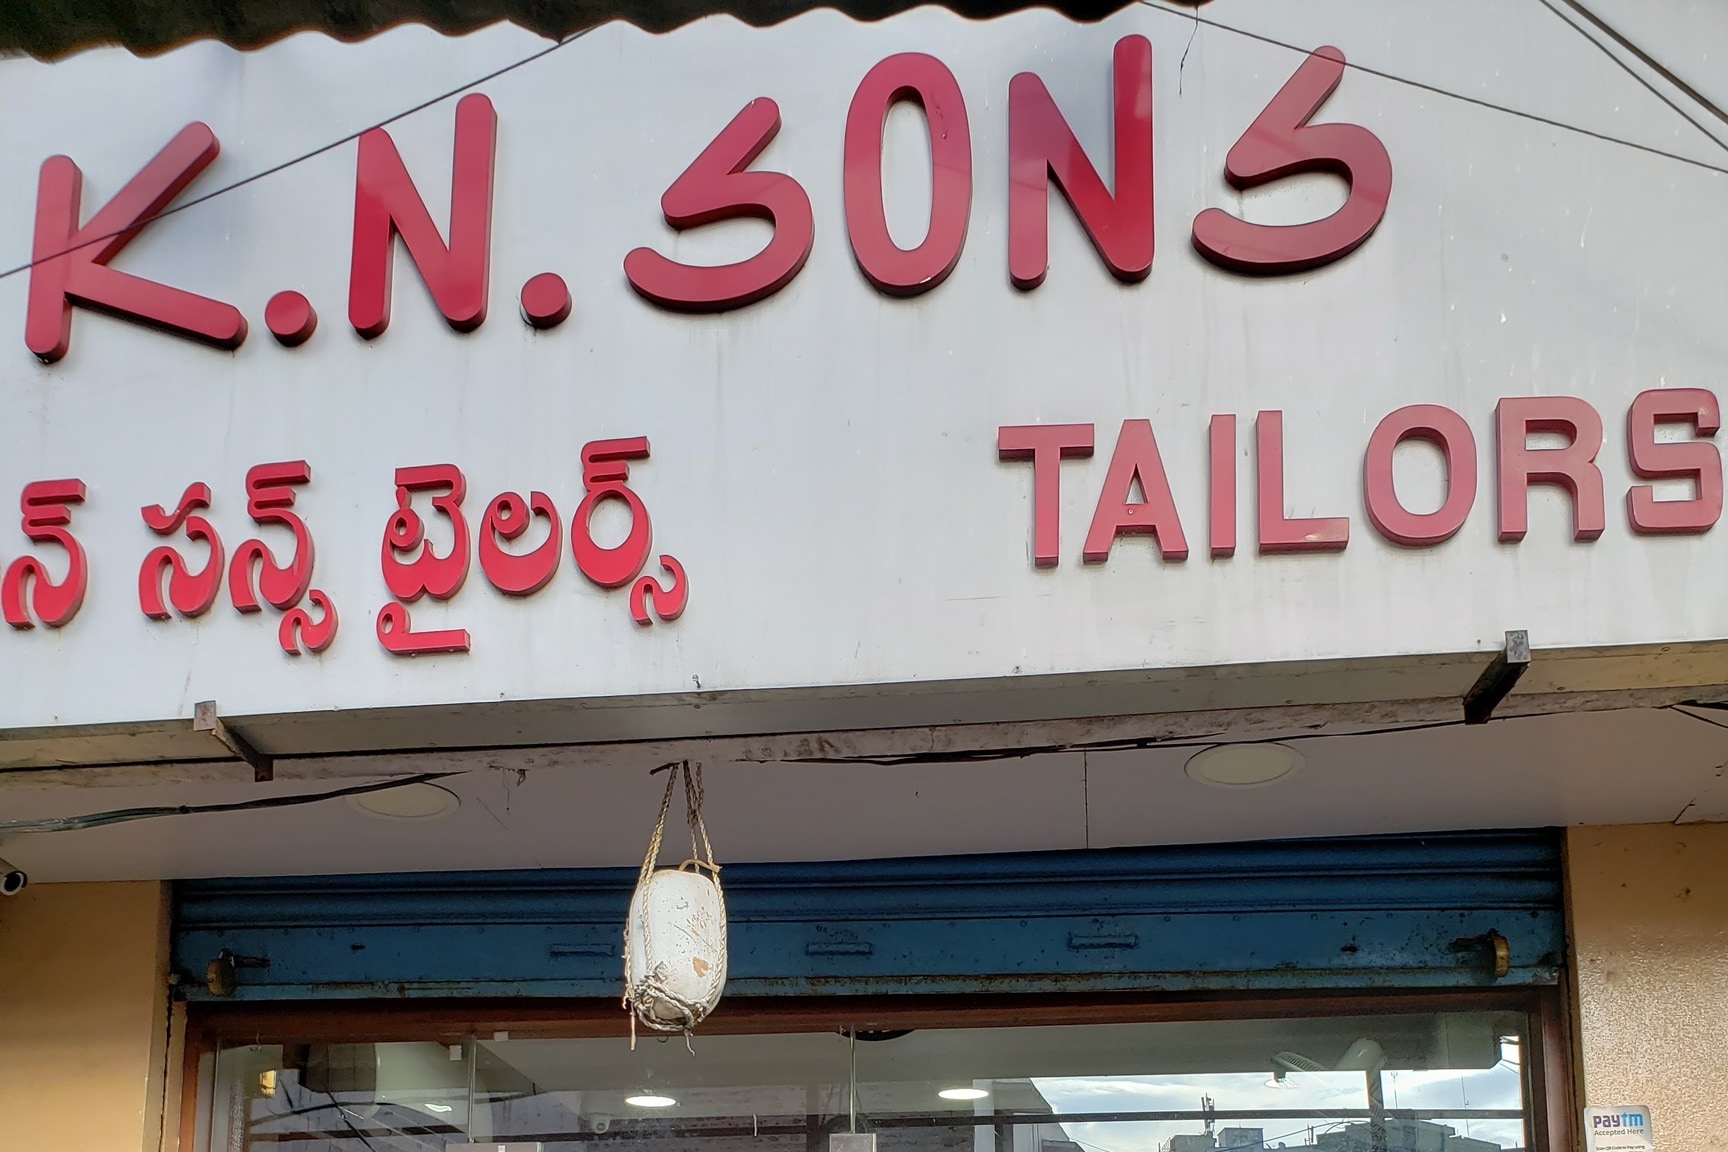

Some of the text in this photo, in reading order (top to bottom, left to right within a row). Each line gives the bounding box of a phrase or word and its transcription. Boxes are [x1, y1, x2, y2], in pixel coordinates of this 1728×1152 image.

[624, 35, 1393, 313] SONS
[138, 460, 339, 656] సన్స్
[376, 437, 688, 656] టైలర్స్
[998, 389, 1724, 568] TAILORS
